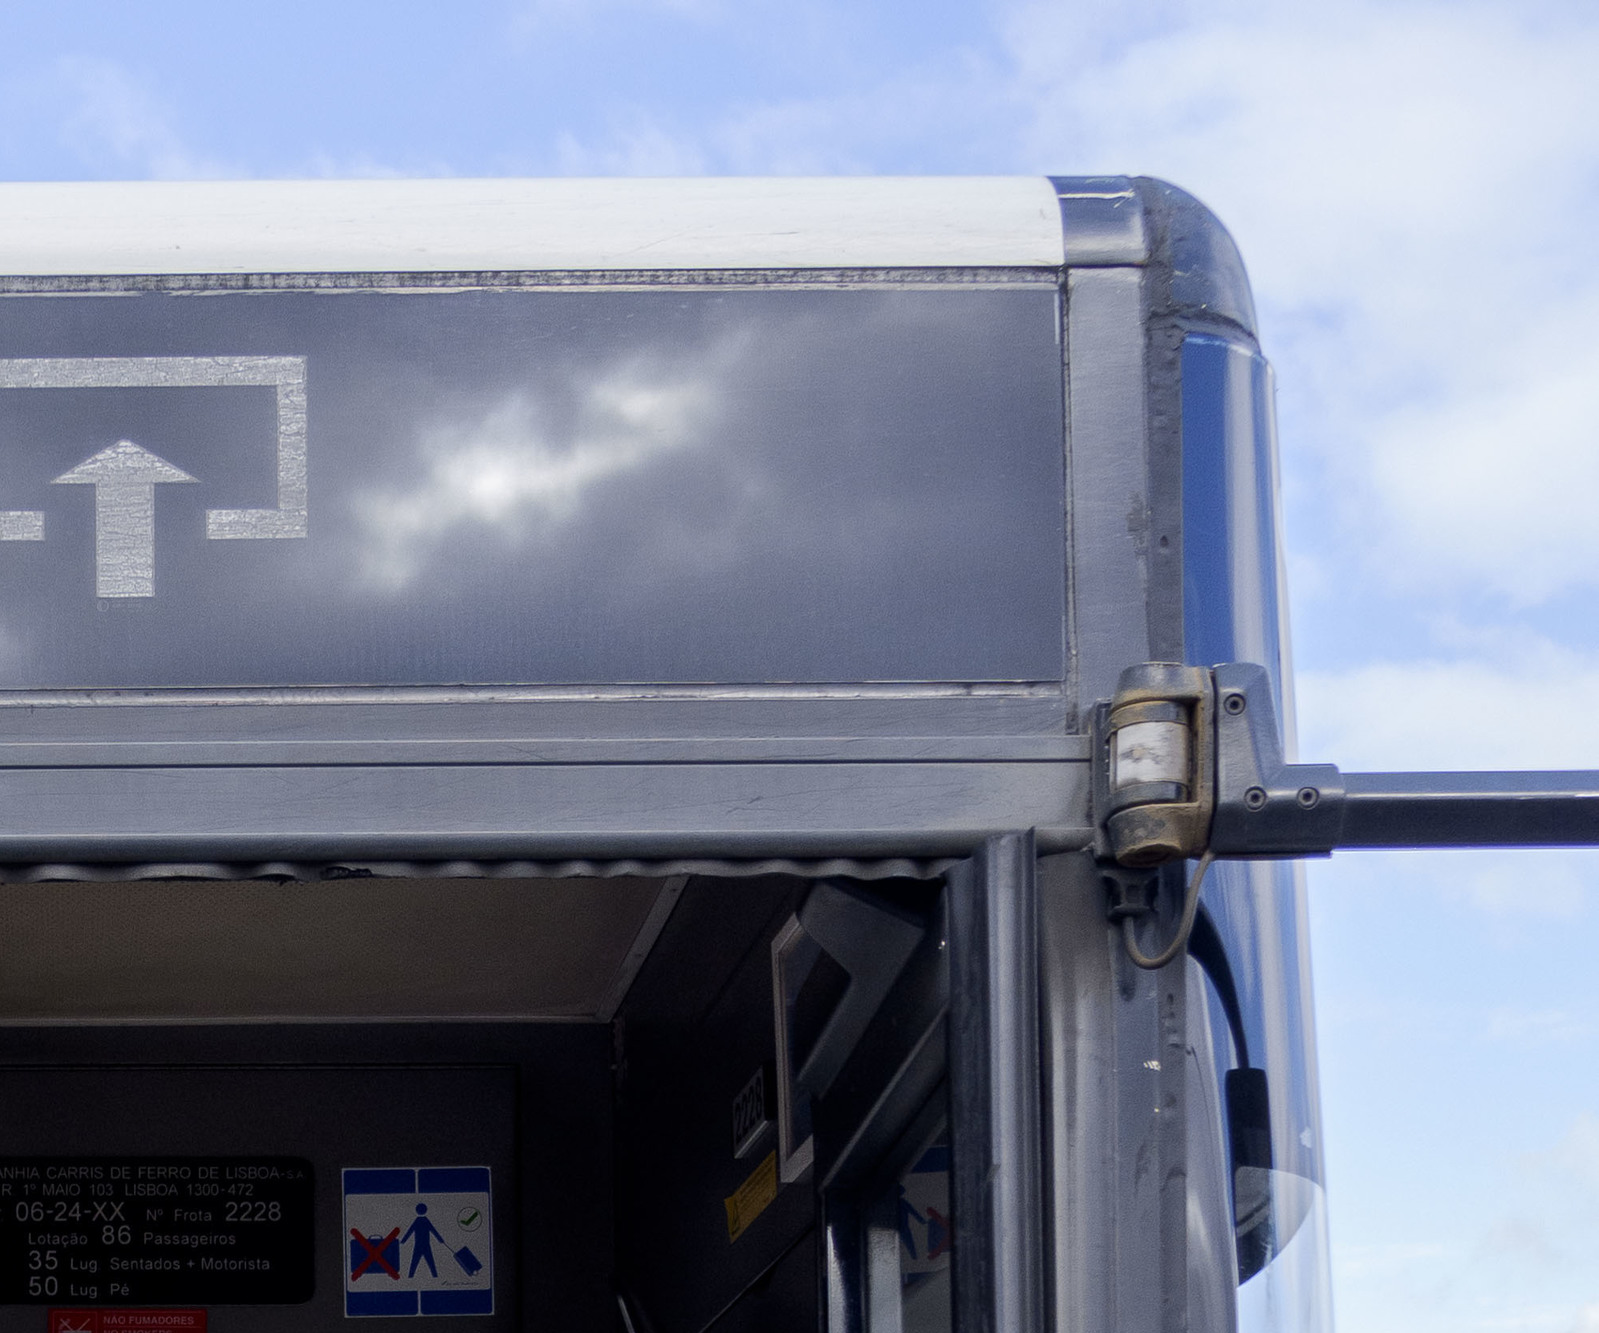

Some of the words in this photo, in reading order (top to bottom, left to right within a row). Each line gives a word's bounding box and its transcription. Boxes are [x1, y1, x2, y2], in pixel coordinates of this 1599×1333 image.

[45, 1166, 105, 1181] CARRIS
[109, 1166, 132, 1180] DE
[137, 1166, 192, 1180] FERRO
[197, 1166, 220, 1180] DE
[23, 1183, 37, 1196] 1º
[42, 1183, 81, 1197] MAIO
[90, 1183, 115, 1197] 103
[124, 1183, 179, 1197] LISBOA
[186, 1183, 255, 1197] 1300-472
[14, 1201, 126, 1222] 06-24-XX
[145, 1208, 164, 1222] Nº
[173, 1208, 213, 1222] Frota
[224, 1200, 283, 1222] 2228
[27, 1231, 89, 1249] Lotação
[101, 1224, 132, 1245] 86
[143, 1232, 237, 1249] Passageiros
[27, 1249, 59, 1270] 35
[109, 1257, 181, 1271] Sentados
[200, 1257, 271, 1271] Motorista
[27, 1275, 59, 1296] 50
[109, 1282, 131, 1296] Pé
[128, 1315, 195, 1326] FUMADORES
